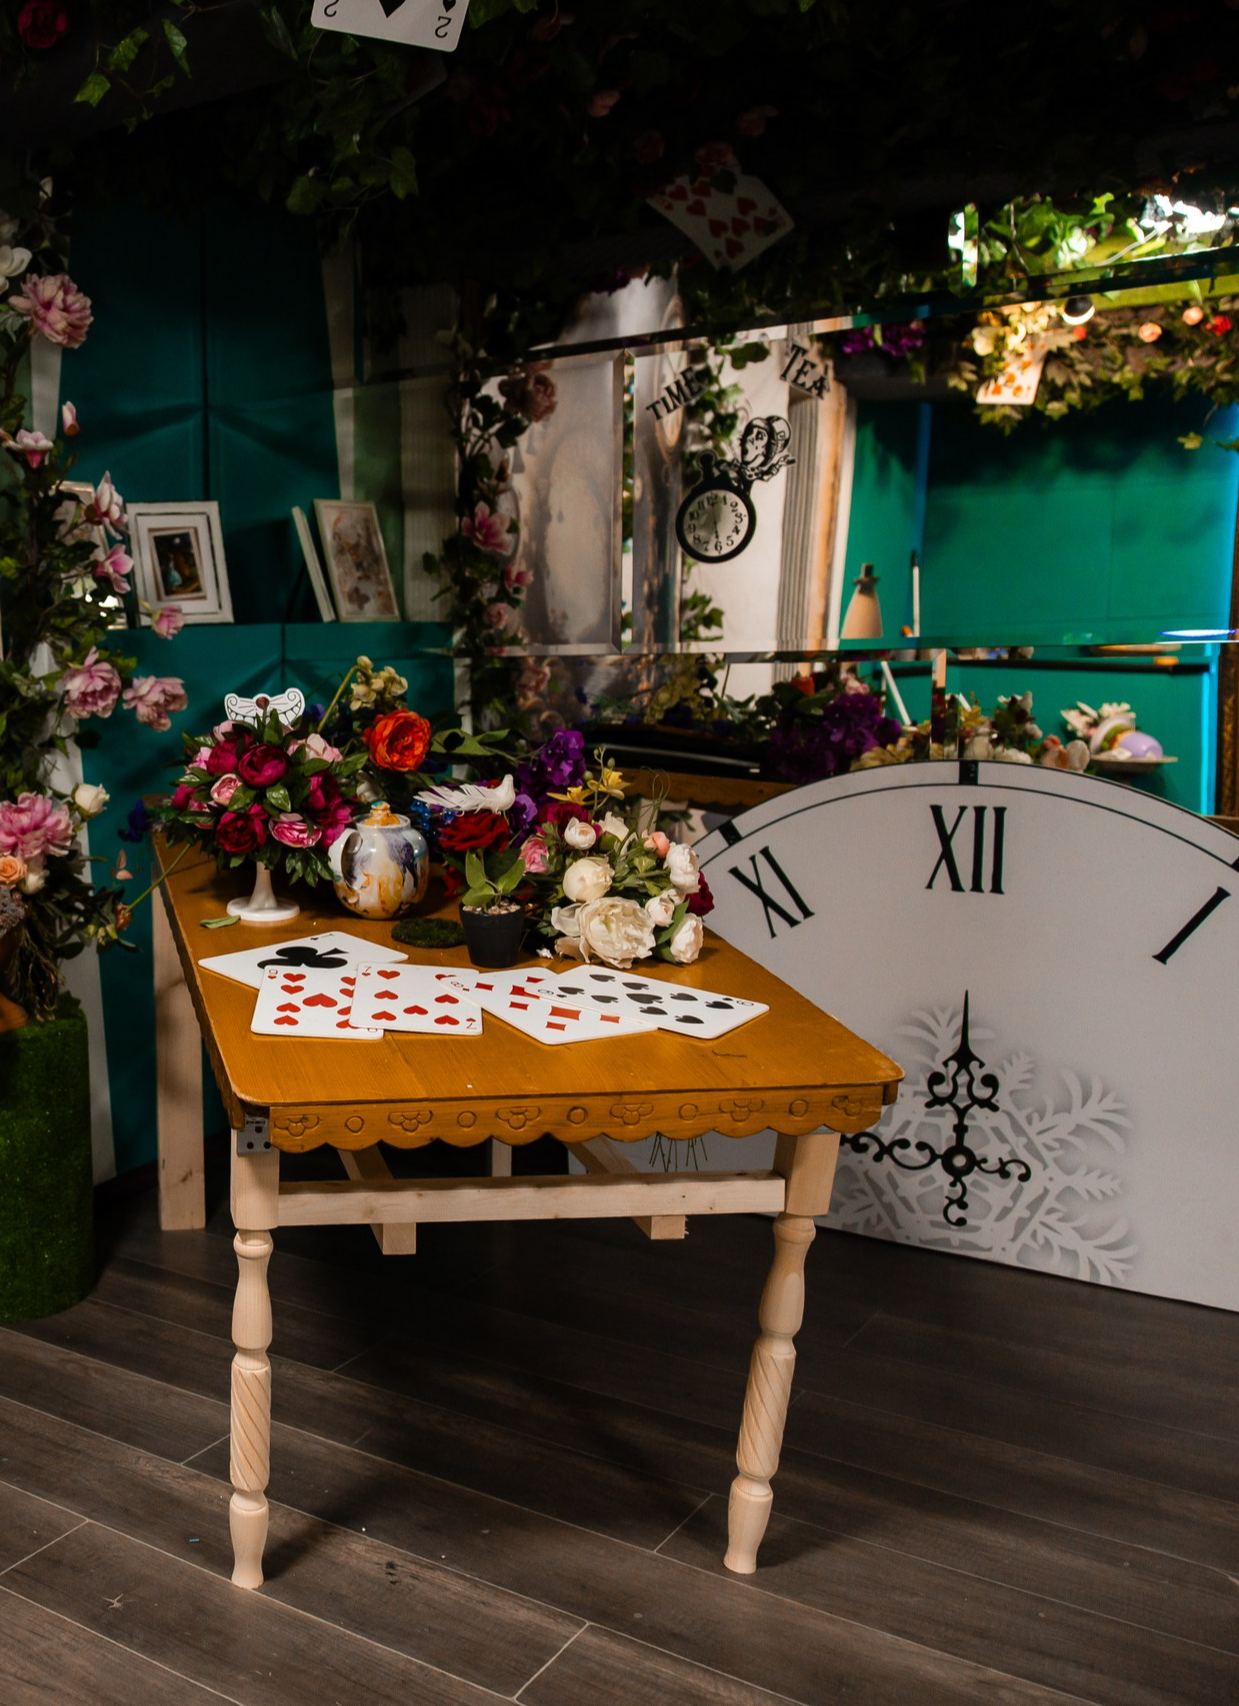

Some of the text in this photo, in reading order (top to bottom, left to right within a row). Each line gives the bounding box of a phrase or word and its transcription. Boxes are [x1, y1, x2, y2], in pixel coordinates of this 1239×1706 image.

[434, 16, 452, 38] 2
[645, 366, 705, 420] TIME
[780, 344, 830, 400] TEA
[925, 804, 1007, 895] XII
[728, 846, 815, 939] XI
[1152, 886, 1231, 965] I
